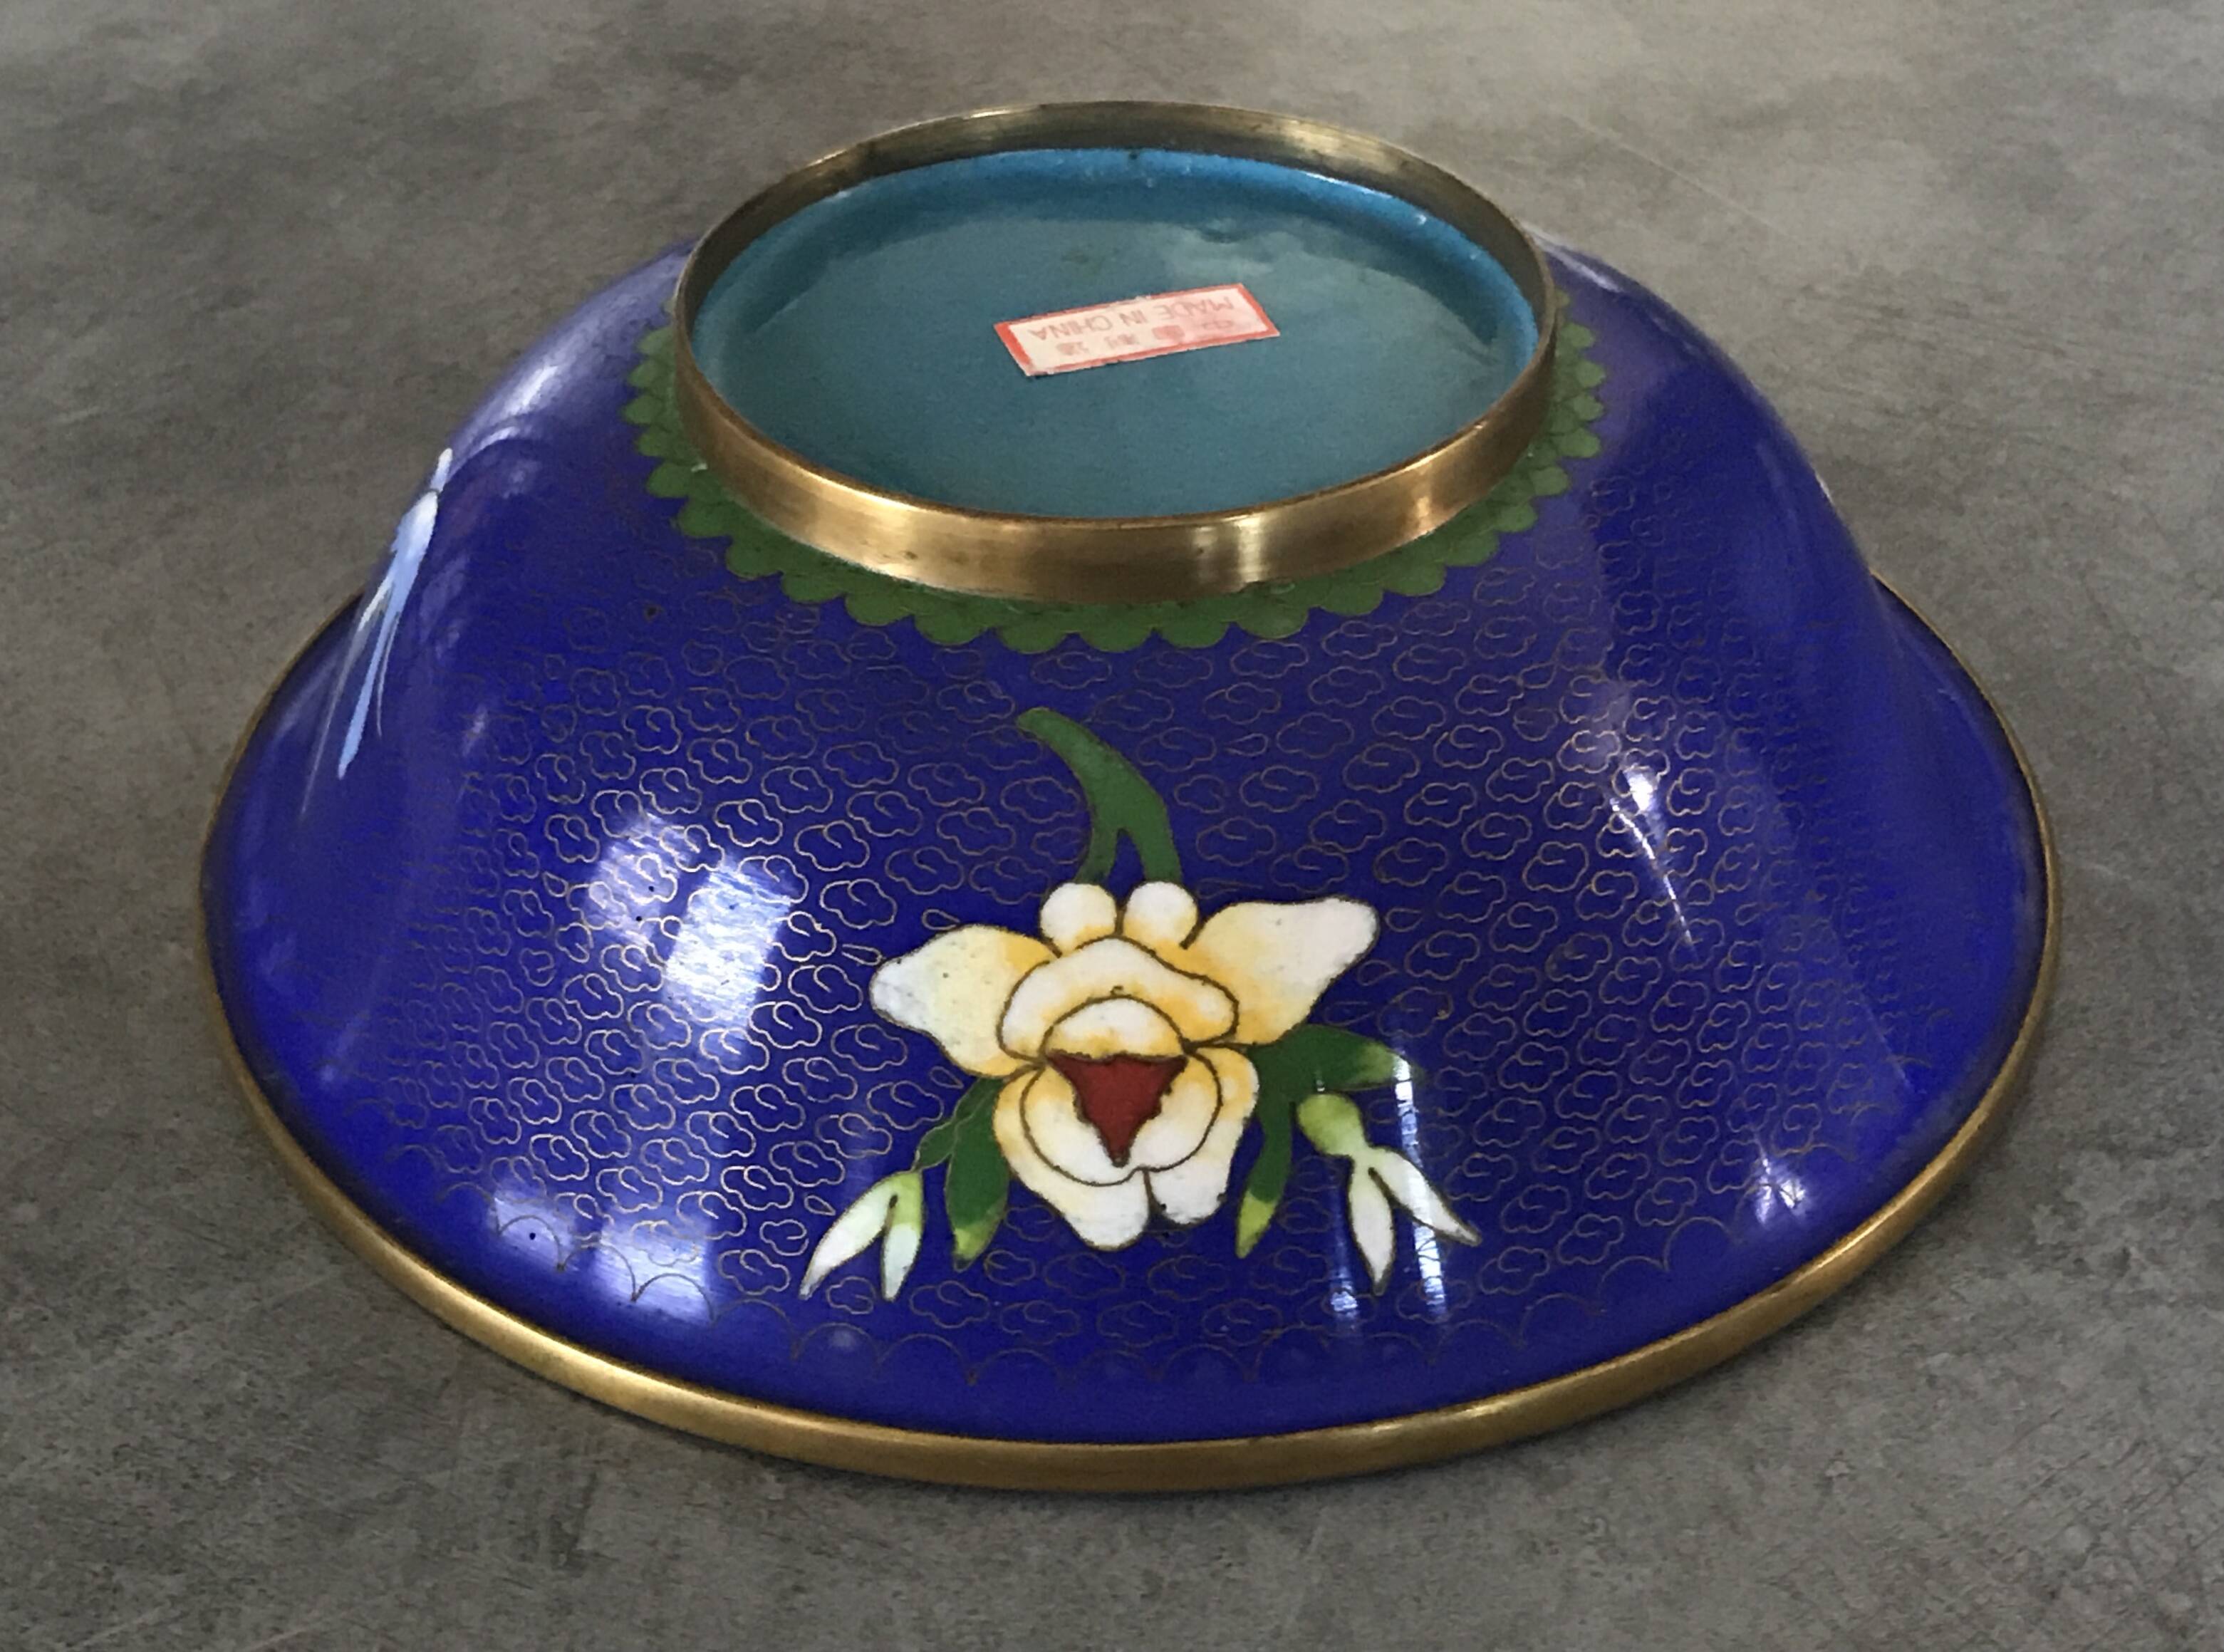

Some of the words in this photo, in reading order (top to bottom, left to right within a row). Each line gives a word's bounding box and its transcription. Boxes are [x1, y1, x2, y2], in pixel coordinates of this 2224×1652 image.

[1119, 309, 1147, 328] IN
[1155, 295, 1235, 321] MADE
[1028, 316, 1113, 341] CHINA
